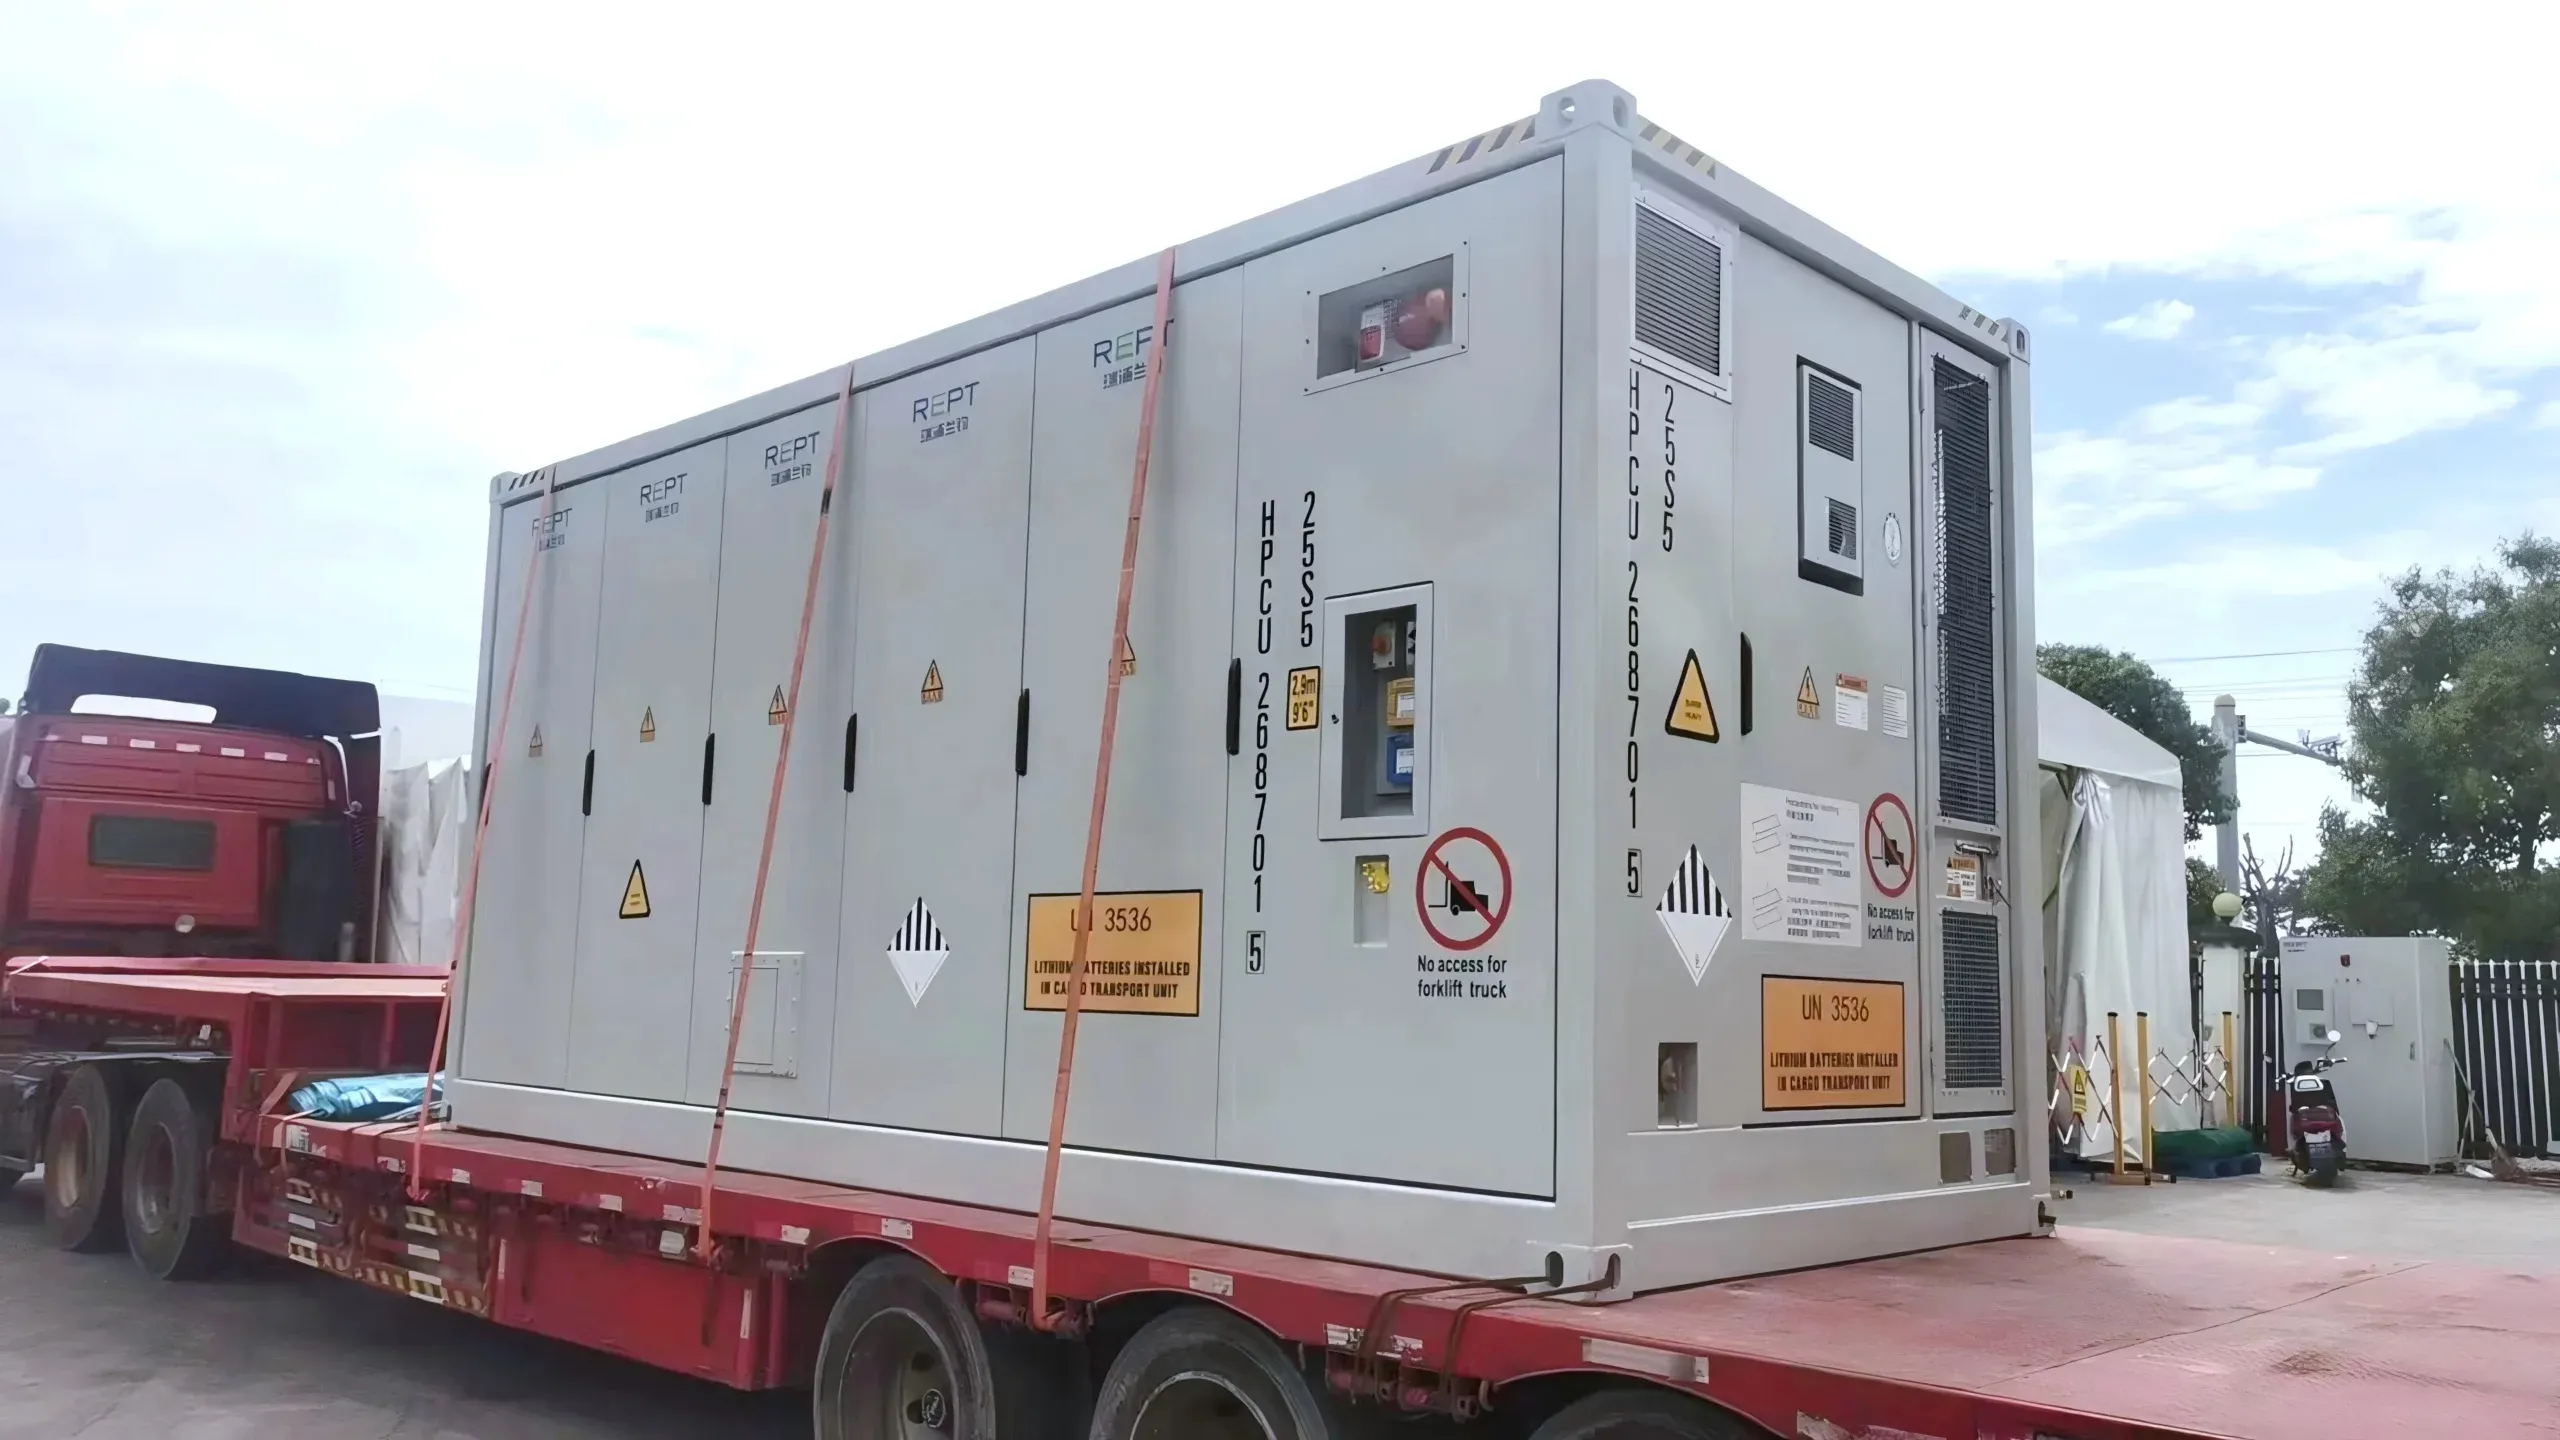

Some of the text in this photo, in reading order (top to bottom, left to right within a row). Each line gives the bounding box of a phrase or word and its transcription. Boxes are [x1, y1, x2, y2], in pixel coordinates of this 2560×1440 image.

[912, 381, 980, 423] REPT
[764, 430, 821, 470] REPT
[1662, 384, 1676, 553] 25S5
[640, 472, 688, 507] REPT
[531, 507, 573, 537] REPT
[1300, 490, 1316, 648] 25S5
[1627, 368, 1640, 894] HPCU 268701 5
[1249, 499, 1275, 972] HPCU 268701 5
[1104, 906, 1152, 932] 3536
[1083, 960, 1131, 976] ATTERIES
[1133, 961, 1190, 977] INSTALLED
[1417, 954, 1508, 973] No access for
[1041, 980, 1178, 999] IN CAO TRANSPORT UNIT
[1417, 979, 1507, 998] forklift truck
[1802, 994, 1870, 1022] UN 3536
[1770, 1052, 1808, 1068] LITHIUM
[1810, 1052, 1855, 1068] BATTERIES
[1790, 1075, 1820, 1091] CARGO
